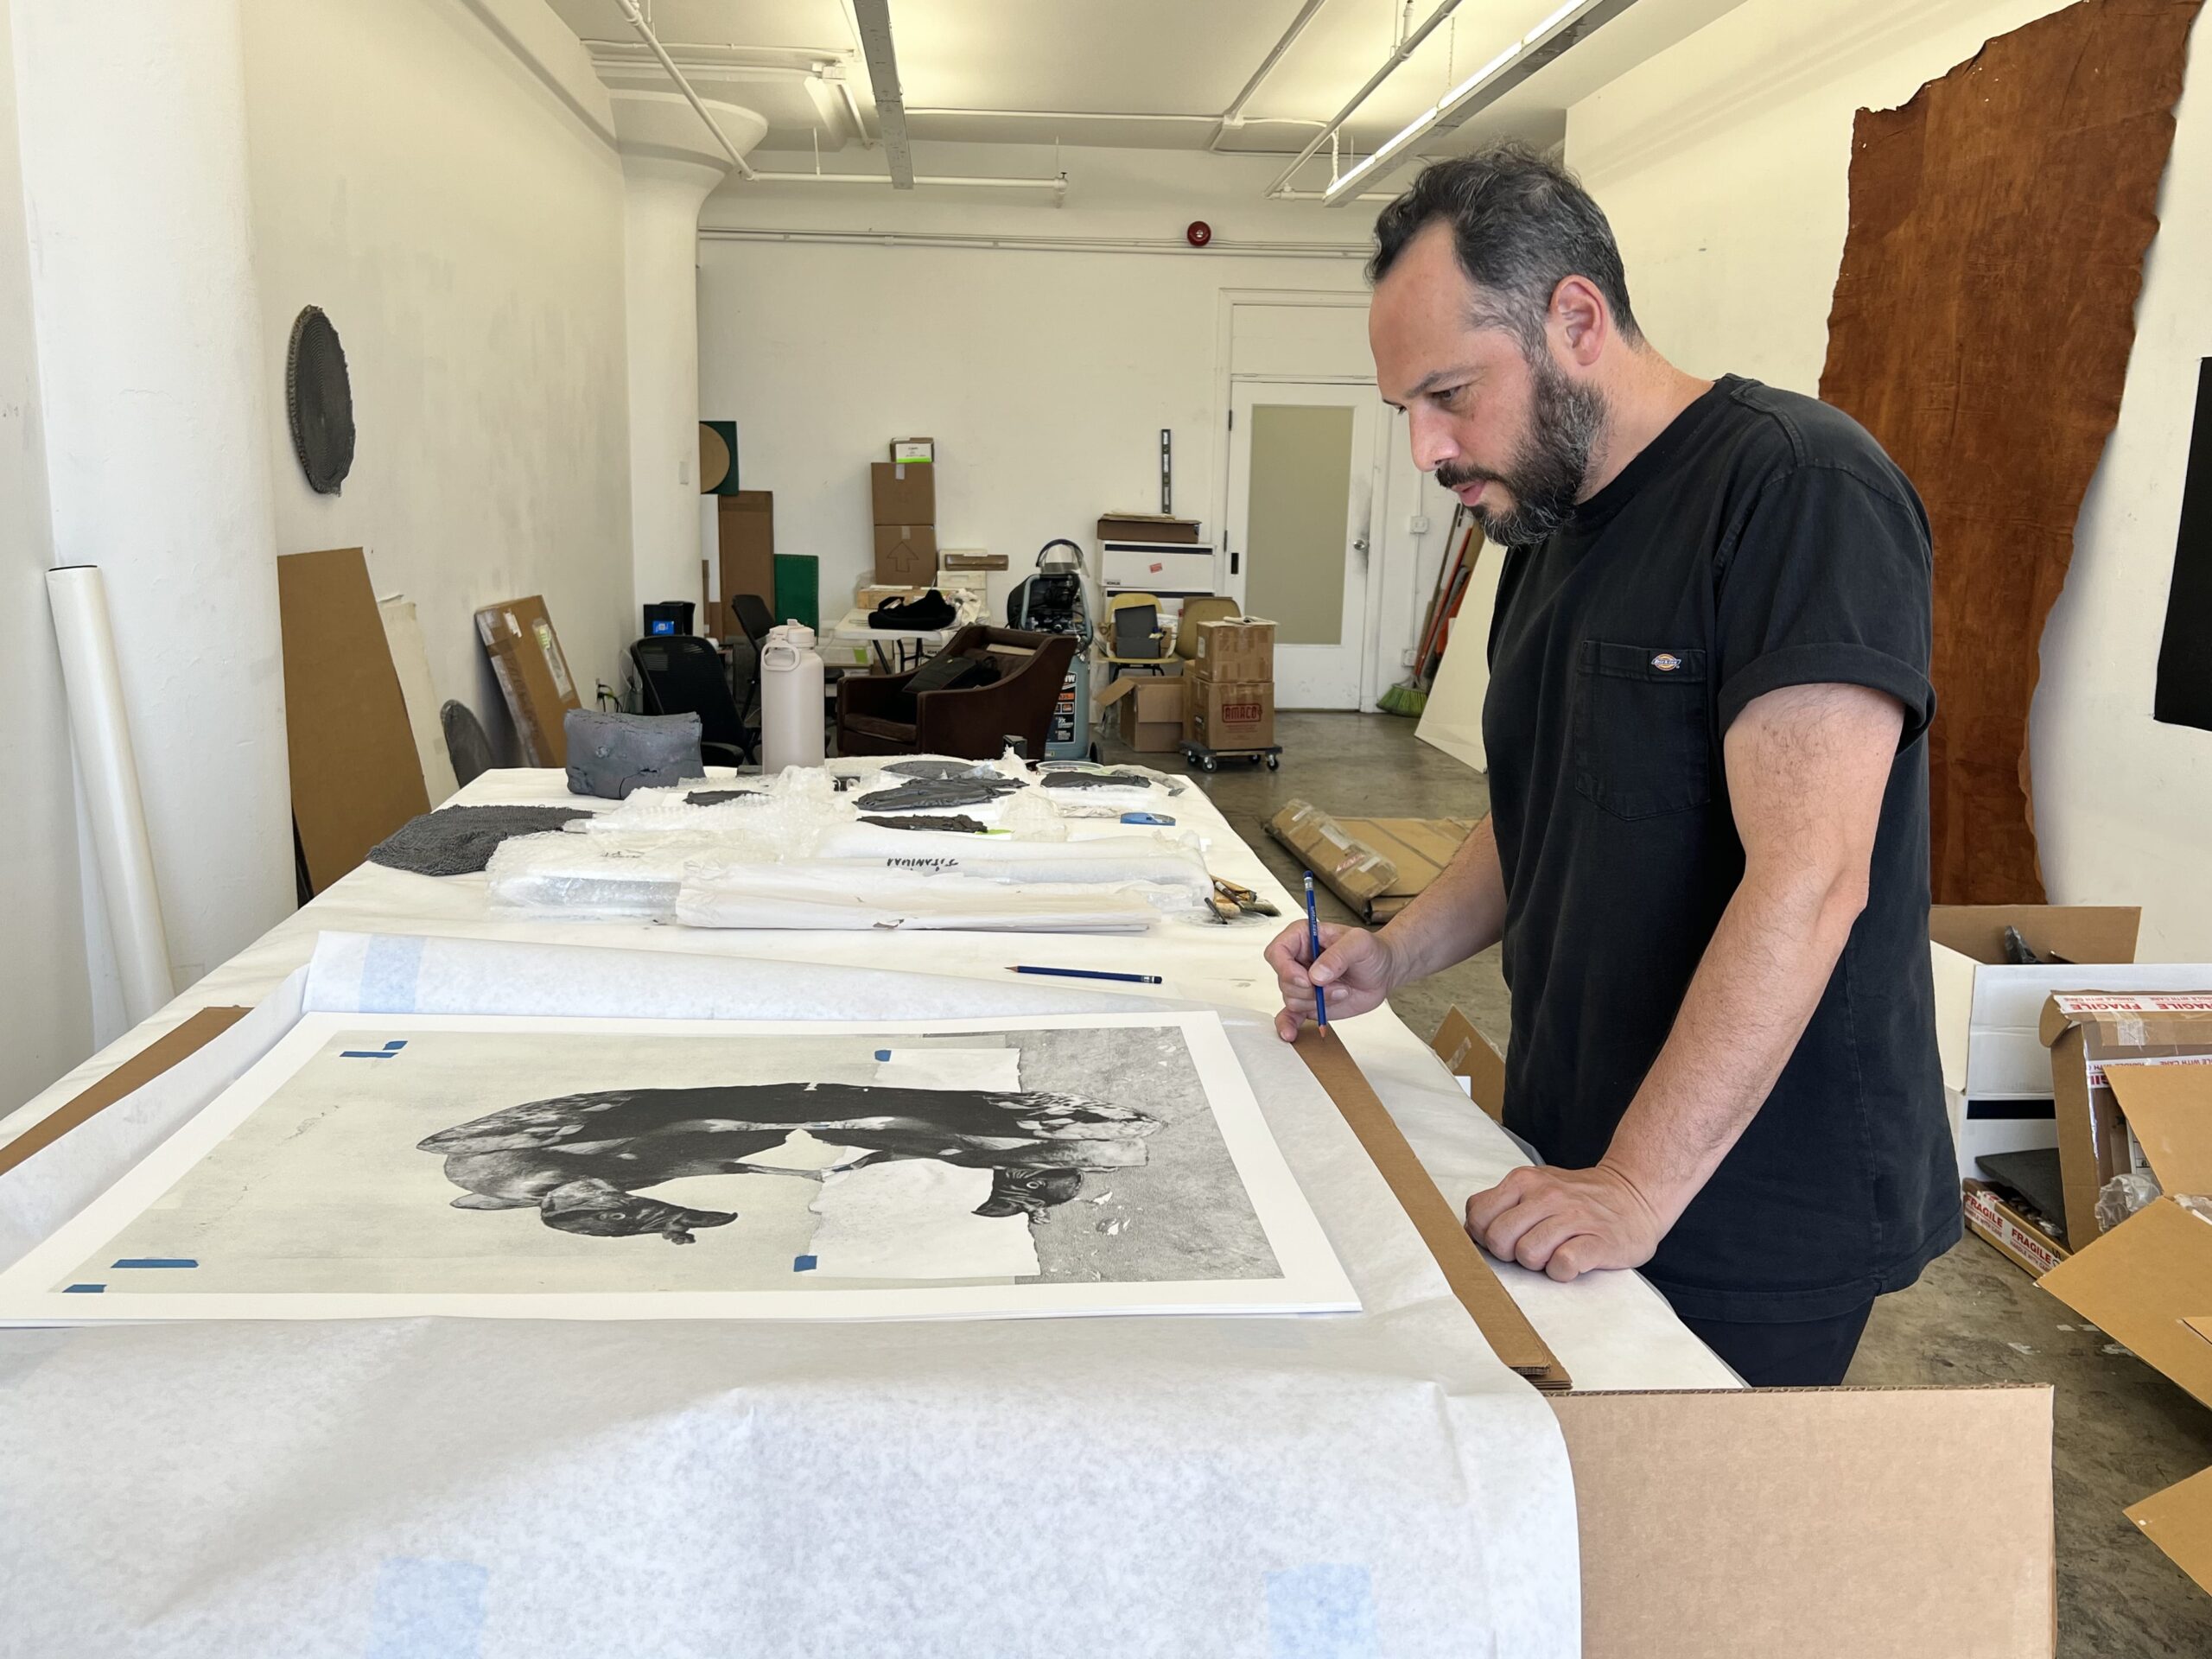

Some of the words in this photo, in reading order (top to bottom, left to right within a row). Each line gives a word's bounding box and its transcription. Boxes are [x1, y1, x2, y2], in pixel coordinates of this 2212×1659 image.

[1224, 706, 1257, 720] AMACO
[1963, 1195, 2004, 1228] FRAGILE
[2012, 1228, 2051, 1265] FRAGILE
